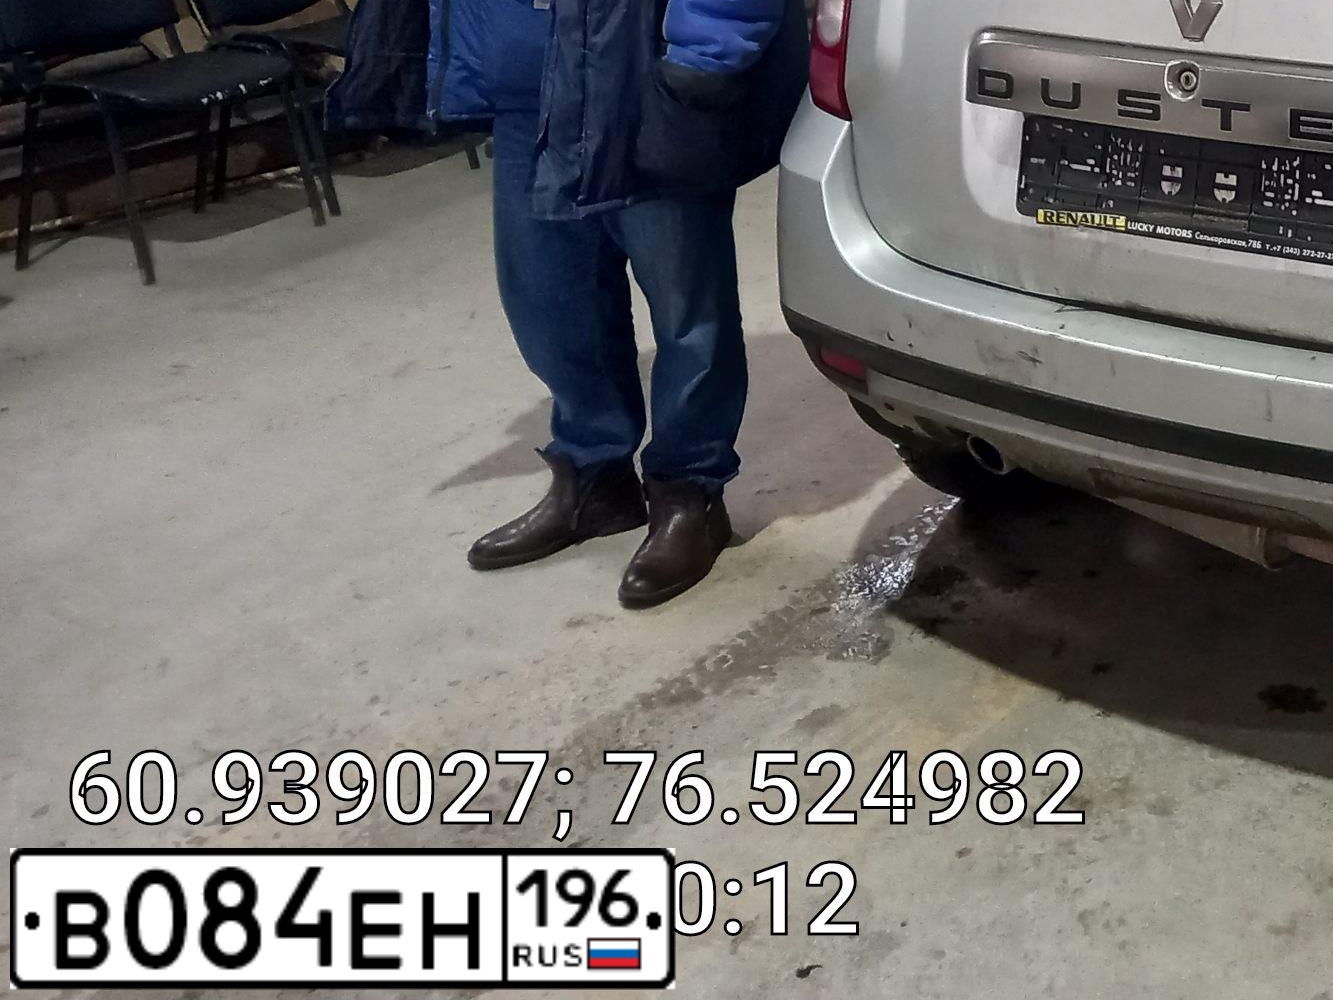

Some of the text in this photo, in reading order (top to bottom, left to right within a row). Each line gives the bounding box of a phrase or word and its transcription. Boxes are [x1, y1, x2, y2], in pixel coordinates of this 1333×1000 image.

[1043, 210, 1121, 229] RENAULT
[1127, 221, 1155, 233] LUCKY
[1156, 226, 1193, 239] MOTORS
